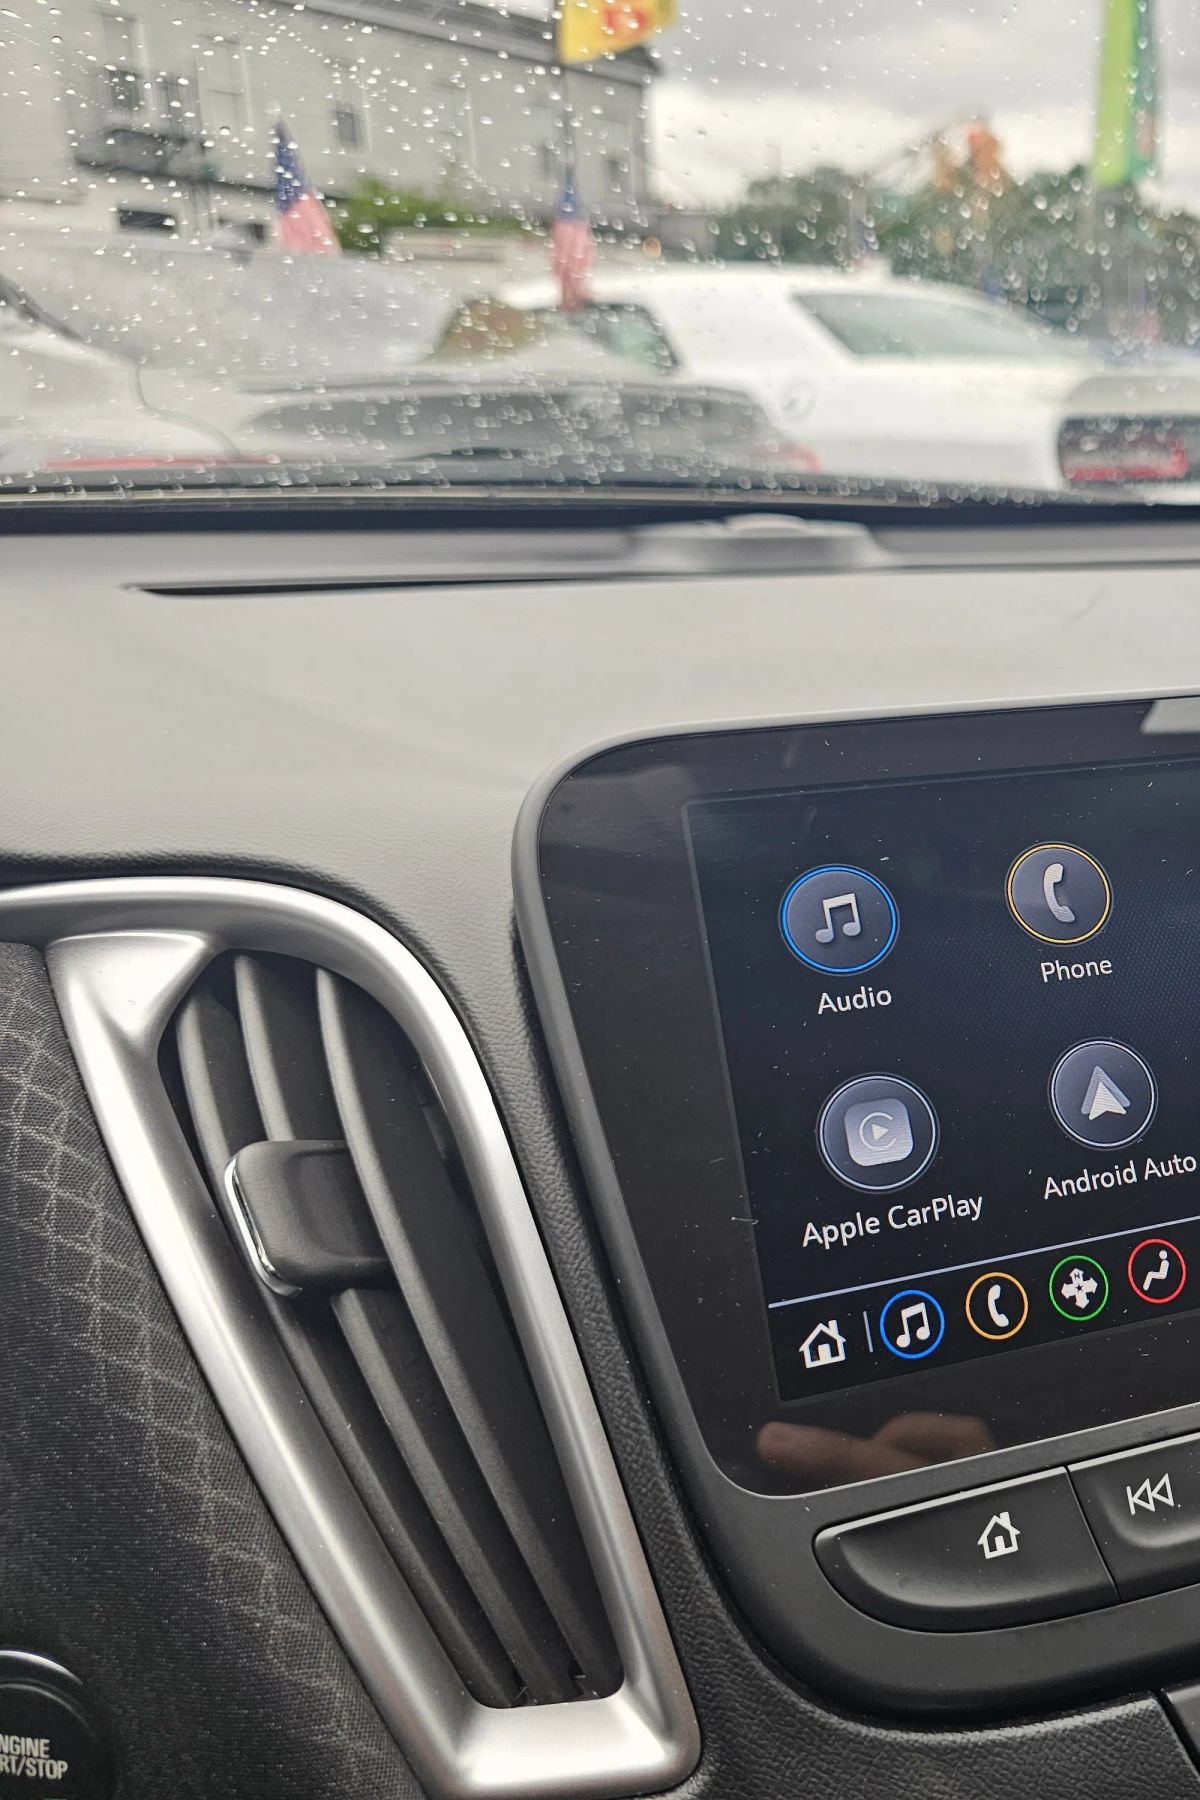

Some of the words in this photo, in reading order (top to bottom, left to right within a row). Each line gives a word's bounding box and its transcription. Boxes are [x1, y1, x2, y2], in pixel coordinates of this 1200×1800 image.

[1040, 958, 1113, 983] Phone
[817, 986, 892, 1014] Audio
[1044, 1159, 1138, 1200] Android
[1144, 1153, 1198, 1181] Auto
[802, 1211, 881, 1250] Apple
[888, 1194, 983, 1230] CarPlay
